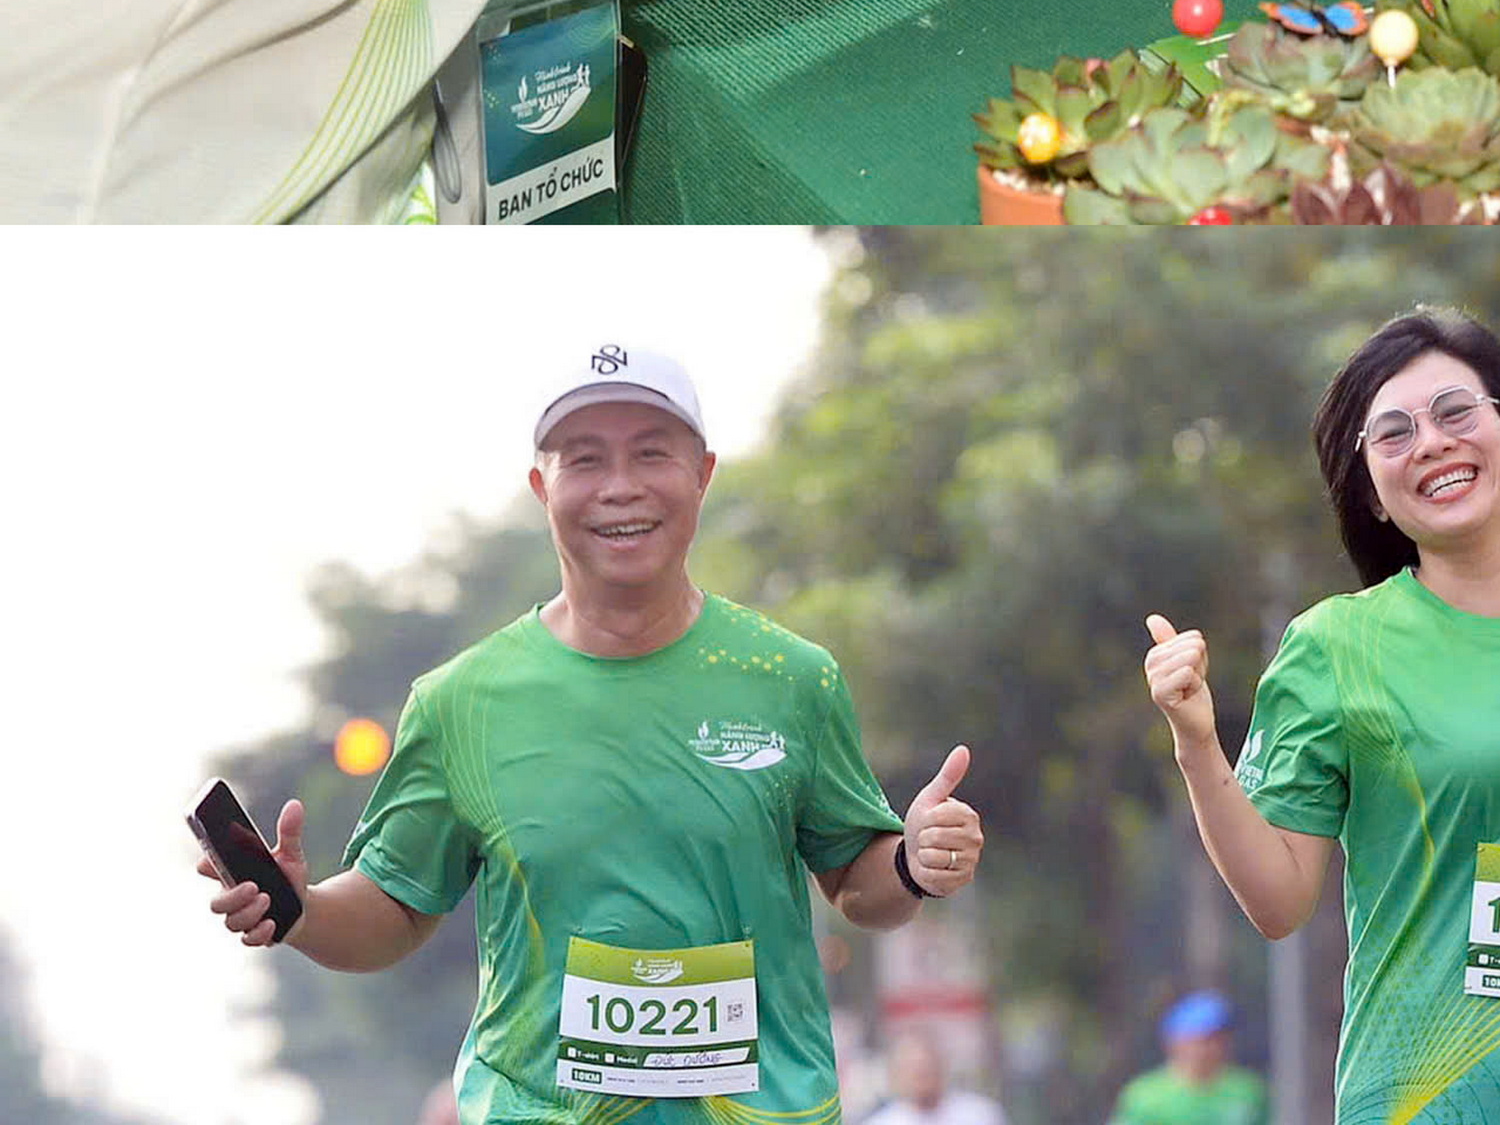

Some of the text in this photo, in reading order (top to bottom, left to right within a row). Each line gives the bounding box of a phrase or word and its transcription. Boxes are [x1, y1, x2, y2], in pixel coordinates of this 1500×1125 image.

[538, 87, 570, 113] XANH
[498, 156, 604, 221] BAN TỔ CHỨC
[722, 740, 760, 753] XANH
[586, 994, 718, 1035] 10221
[577, 1050, 600, 1060] T-shirt
[573, 1069, 601, 1083] 10KM
